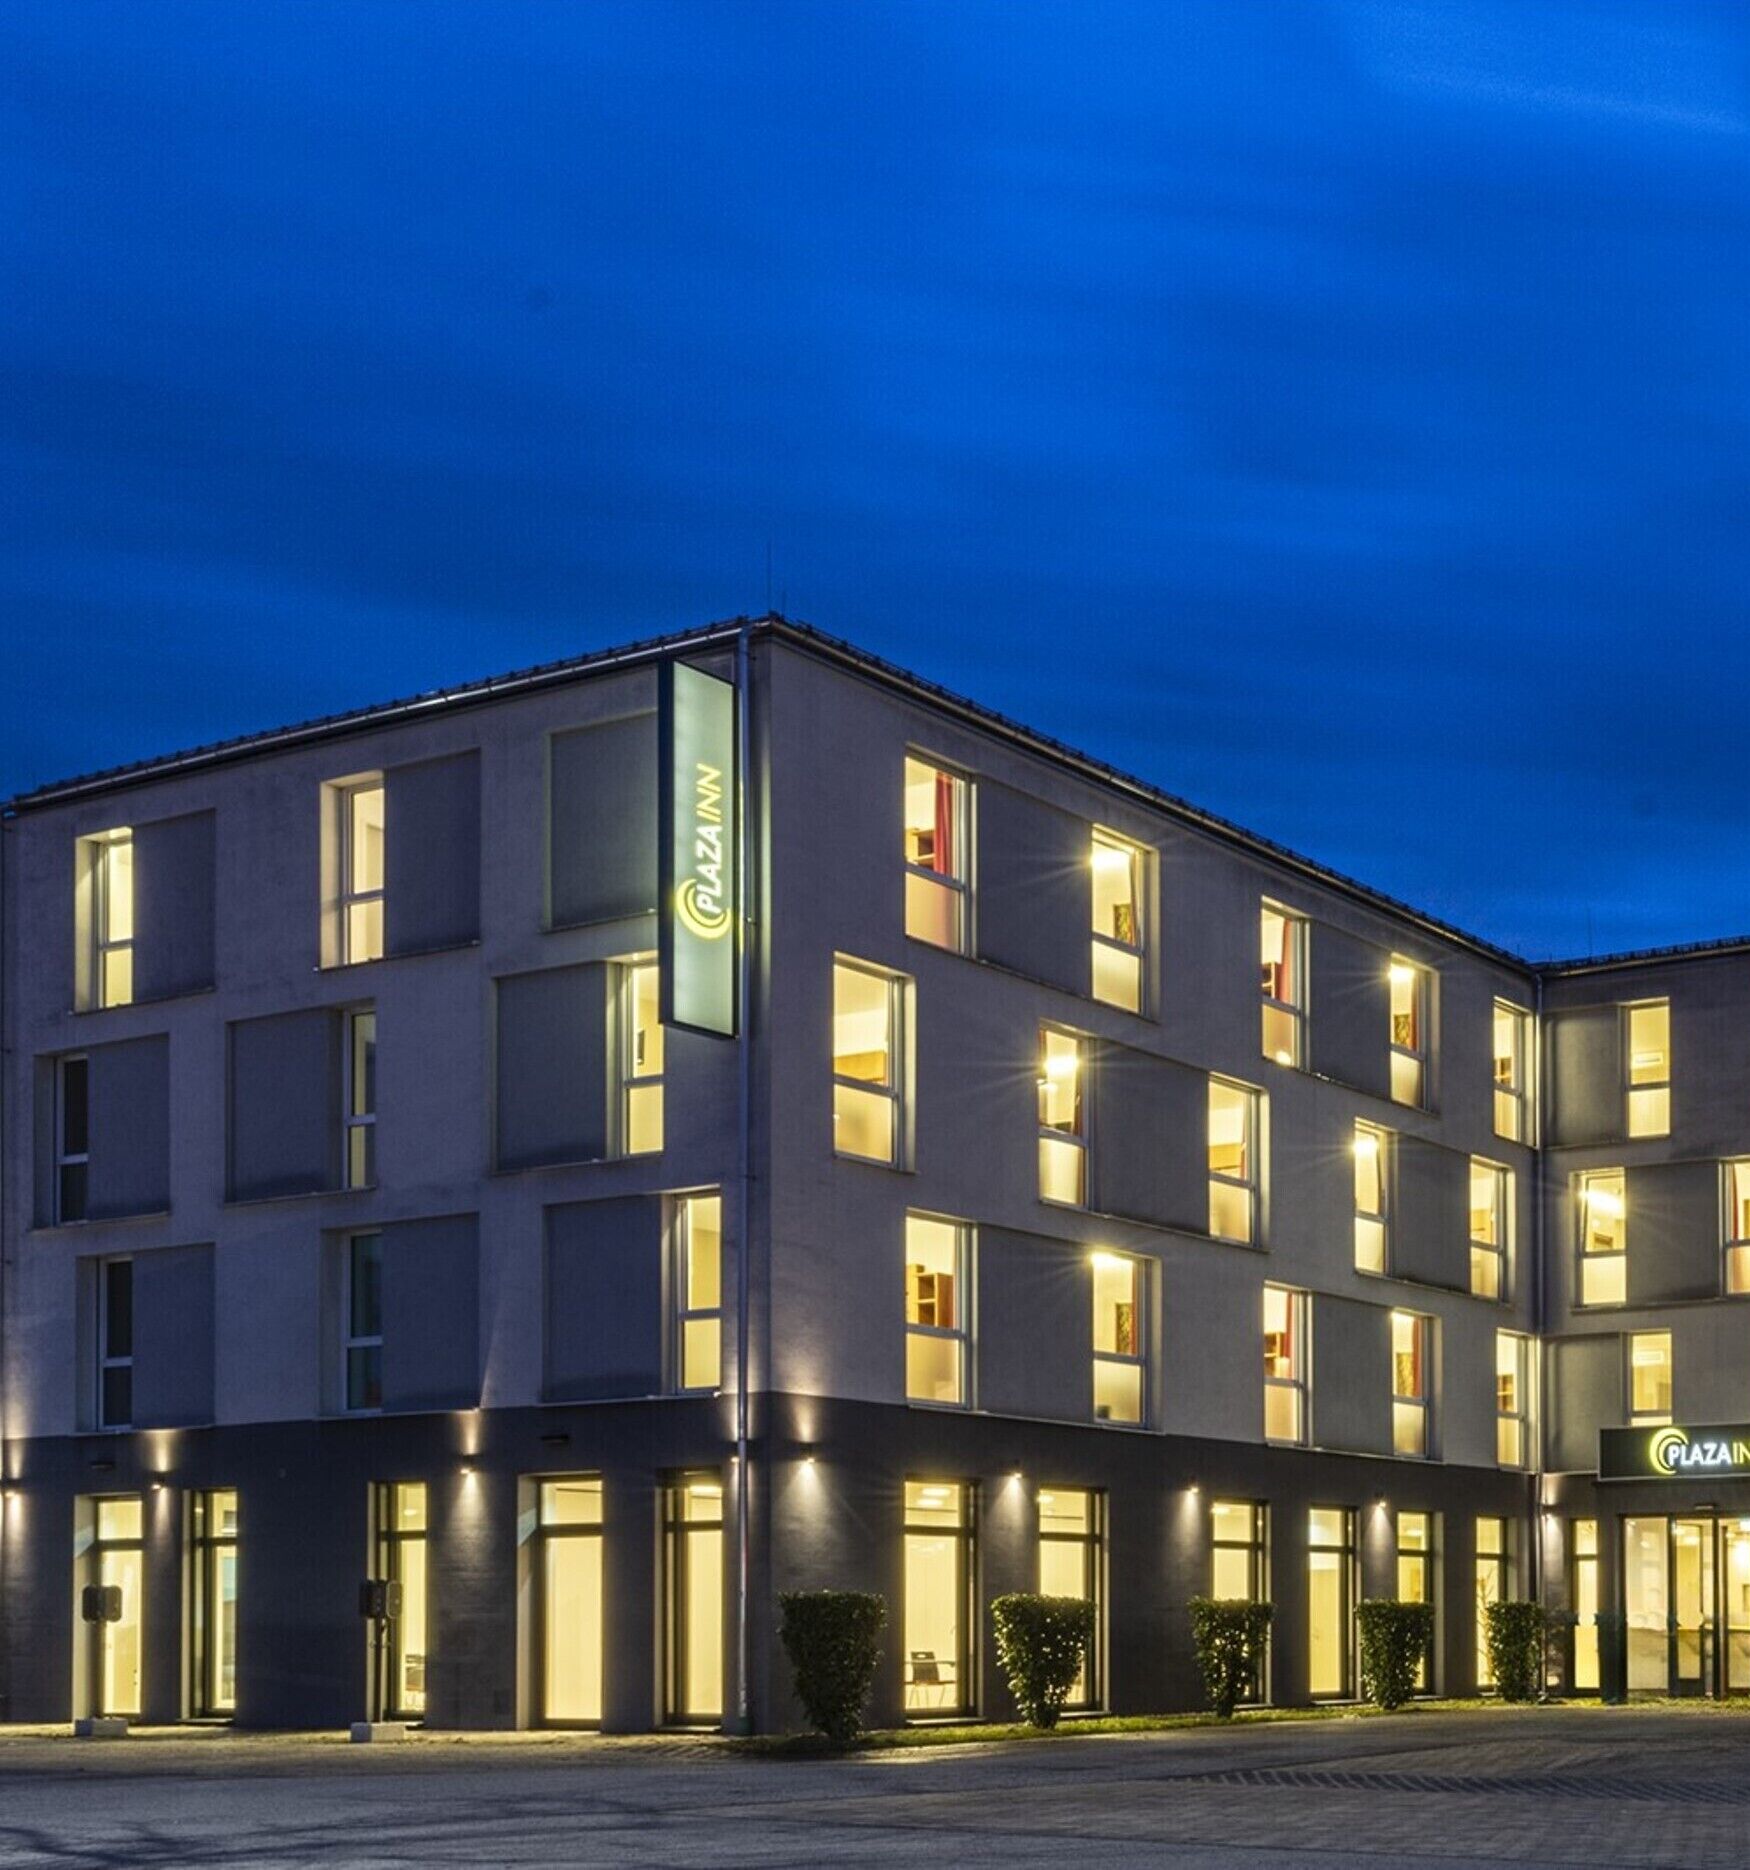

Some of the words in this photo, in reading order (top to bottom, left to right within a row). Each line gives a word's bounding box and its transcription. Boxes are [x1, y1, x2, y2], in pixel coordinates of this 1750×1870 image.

[696, 763, 722, 822] INN
[695, 825, 723, 914] PLAZA
[1668, 1442, 1731, 1466] PLAZA
